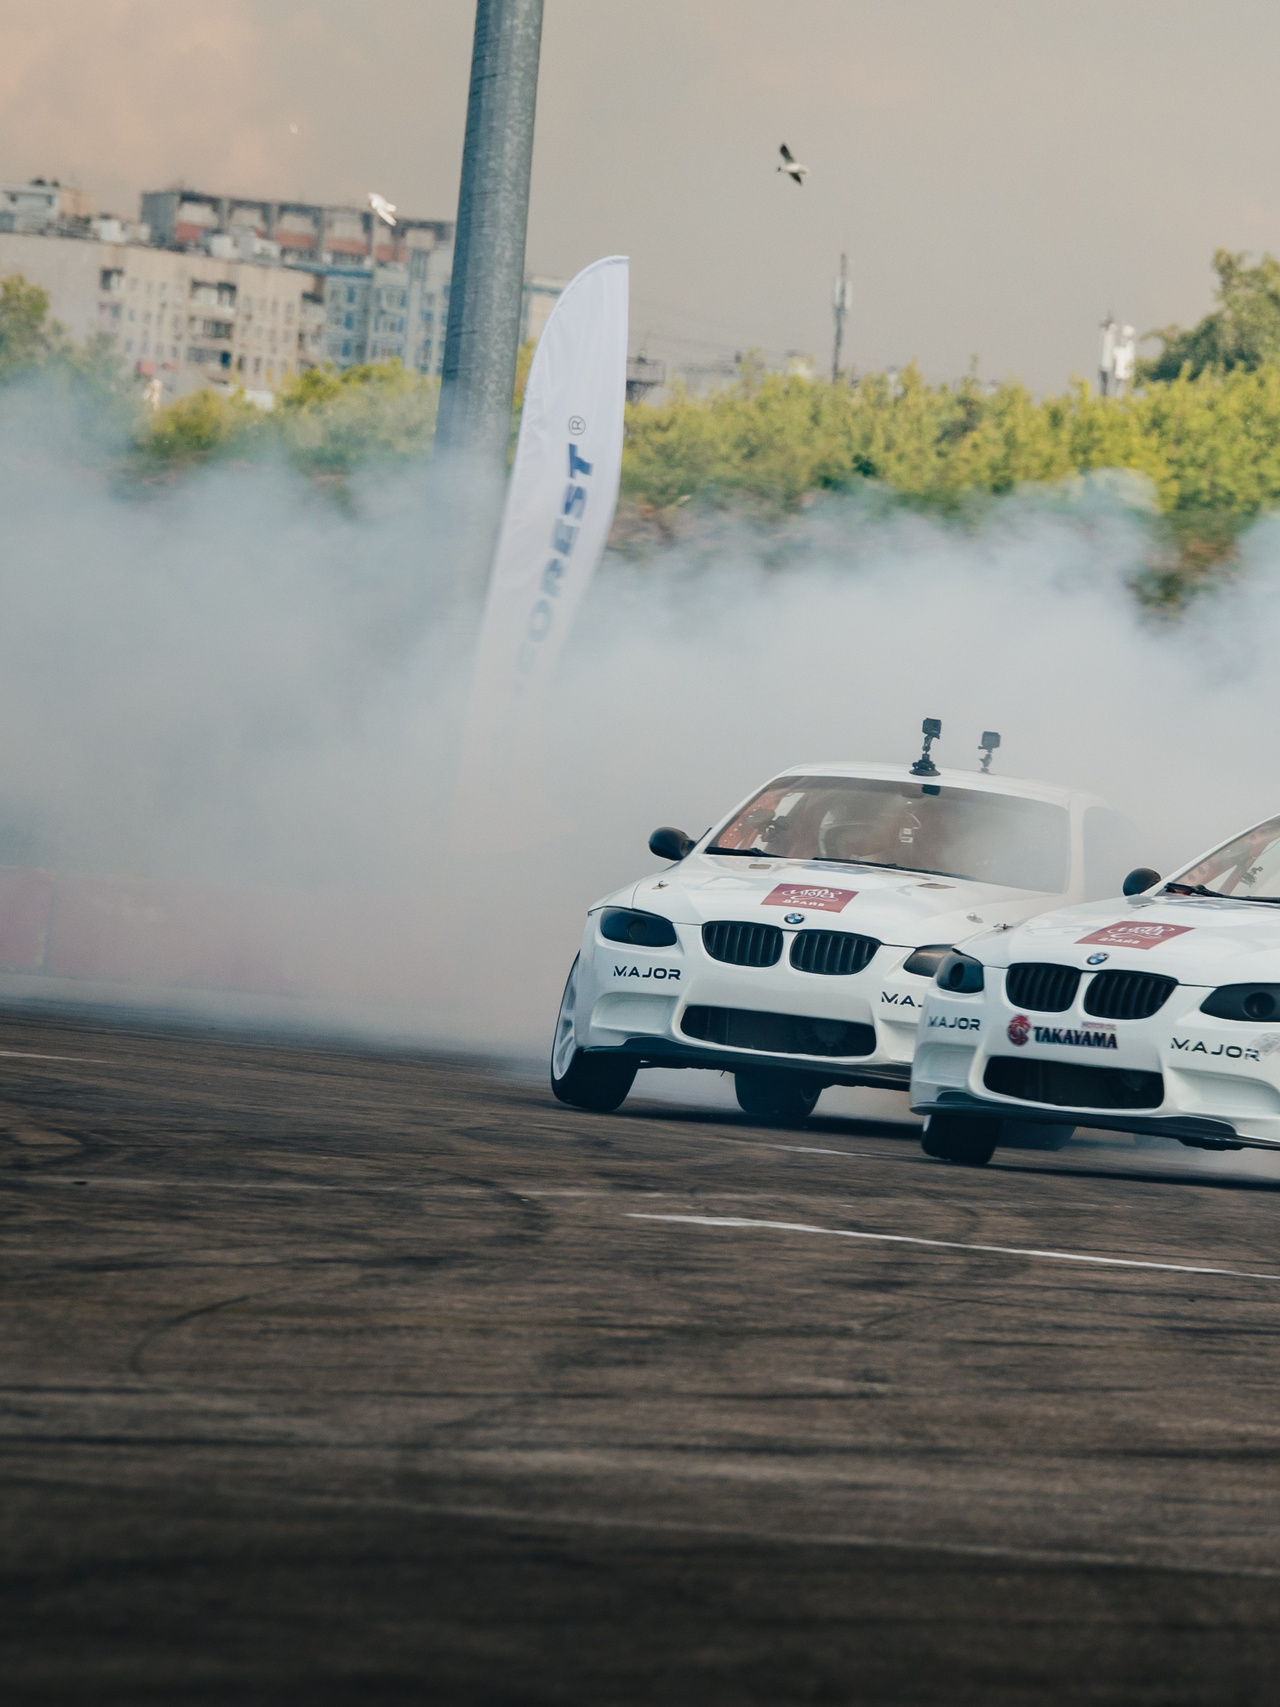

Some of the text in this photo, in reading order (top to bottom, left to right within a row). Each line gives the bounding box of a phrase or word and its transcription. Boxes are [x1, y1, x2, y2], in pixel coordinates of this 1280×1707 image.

[613, 965, 681, 981] MAJOR
[881, 991, 923, 1008] MA
[927, 1016, 981, 1031] MAJOR
[1033, 1026, 1118, 1049] TAKAYAMA
[1170, 1037, 1260, 1062] MAJOR
